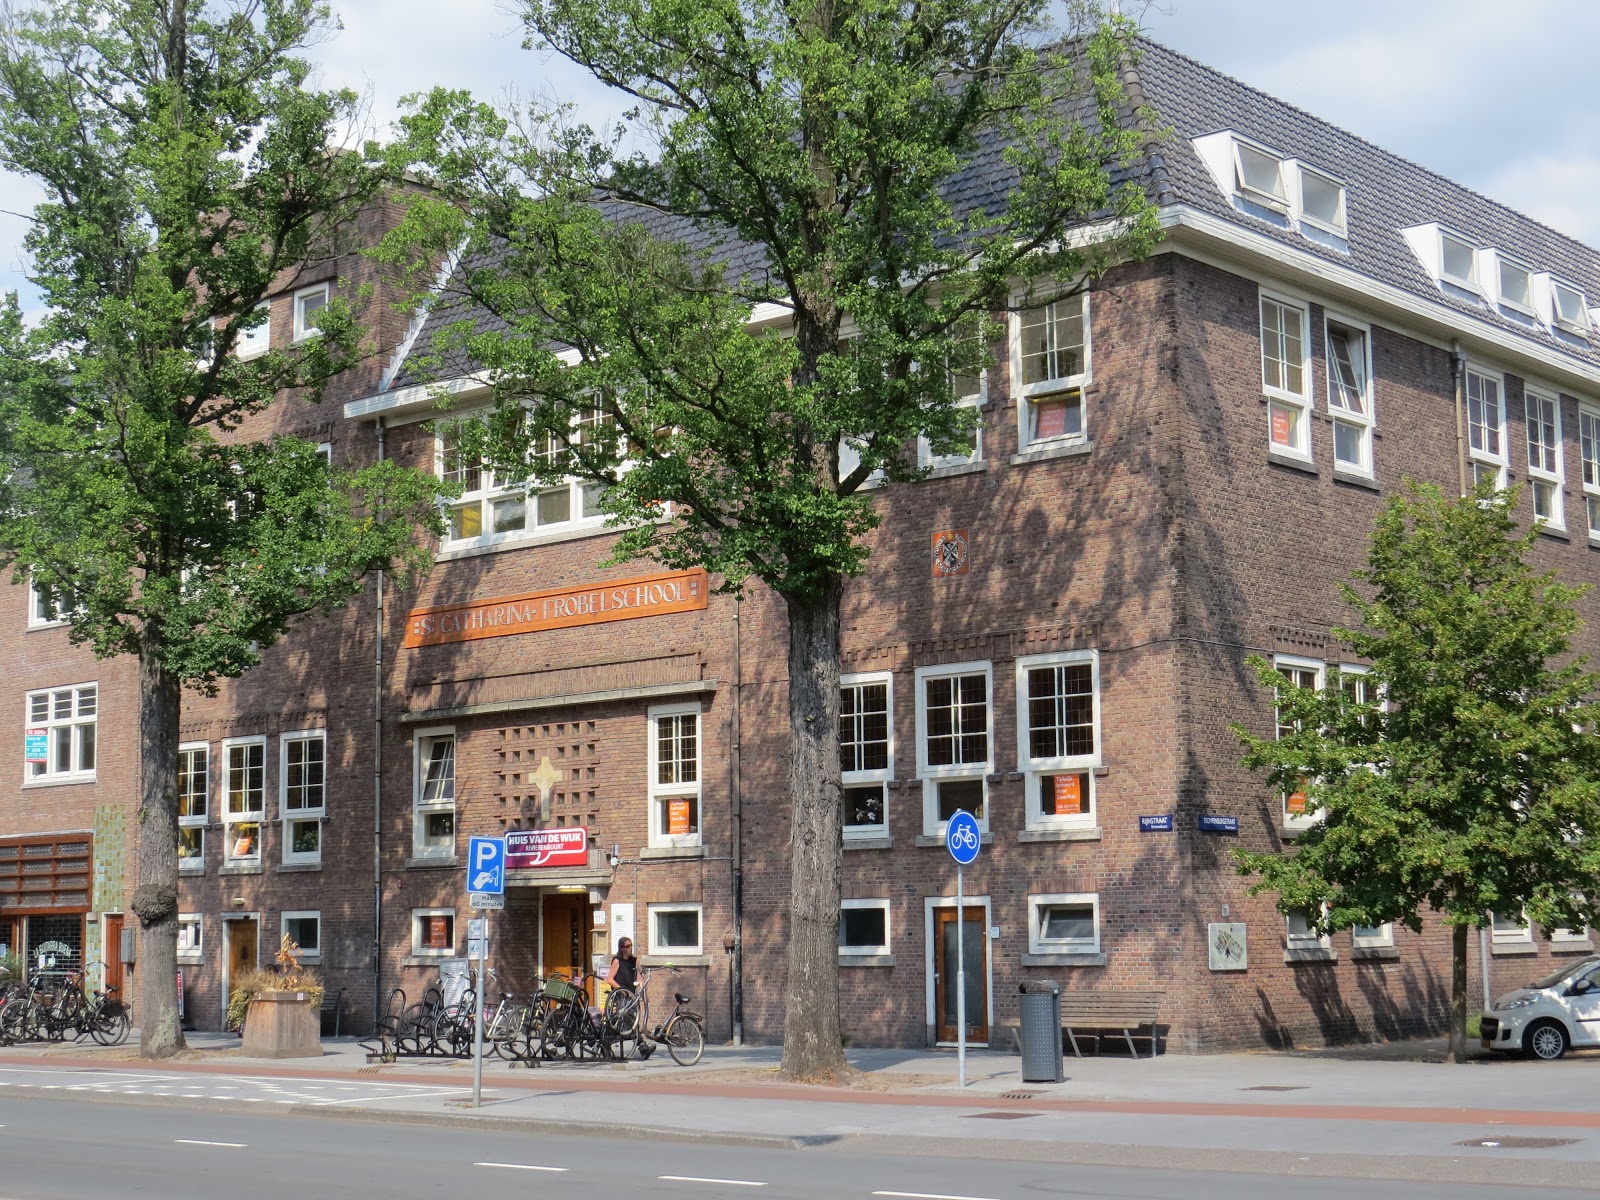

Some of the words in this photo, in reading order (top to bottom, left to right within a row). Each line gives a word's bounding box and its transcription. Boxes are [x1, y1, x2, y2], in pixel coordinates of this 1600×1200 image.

[508, 836, 528, 845] HUIS
[529, 835, 547, 844] VAN
[548, 834, 560, 843] DE
[560, 832, 582, 842] WIJK
[525, 843, 564, 851] RIVIERENBUURT
[476, 842, 497, 870] P
[595, 915, 604, 923] 115
